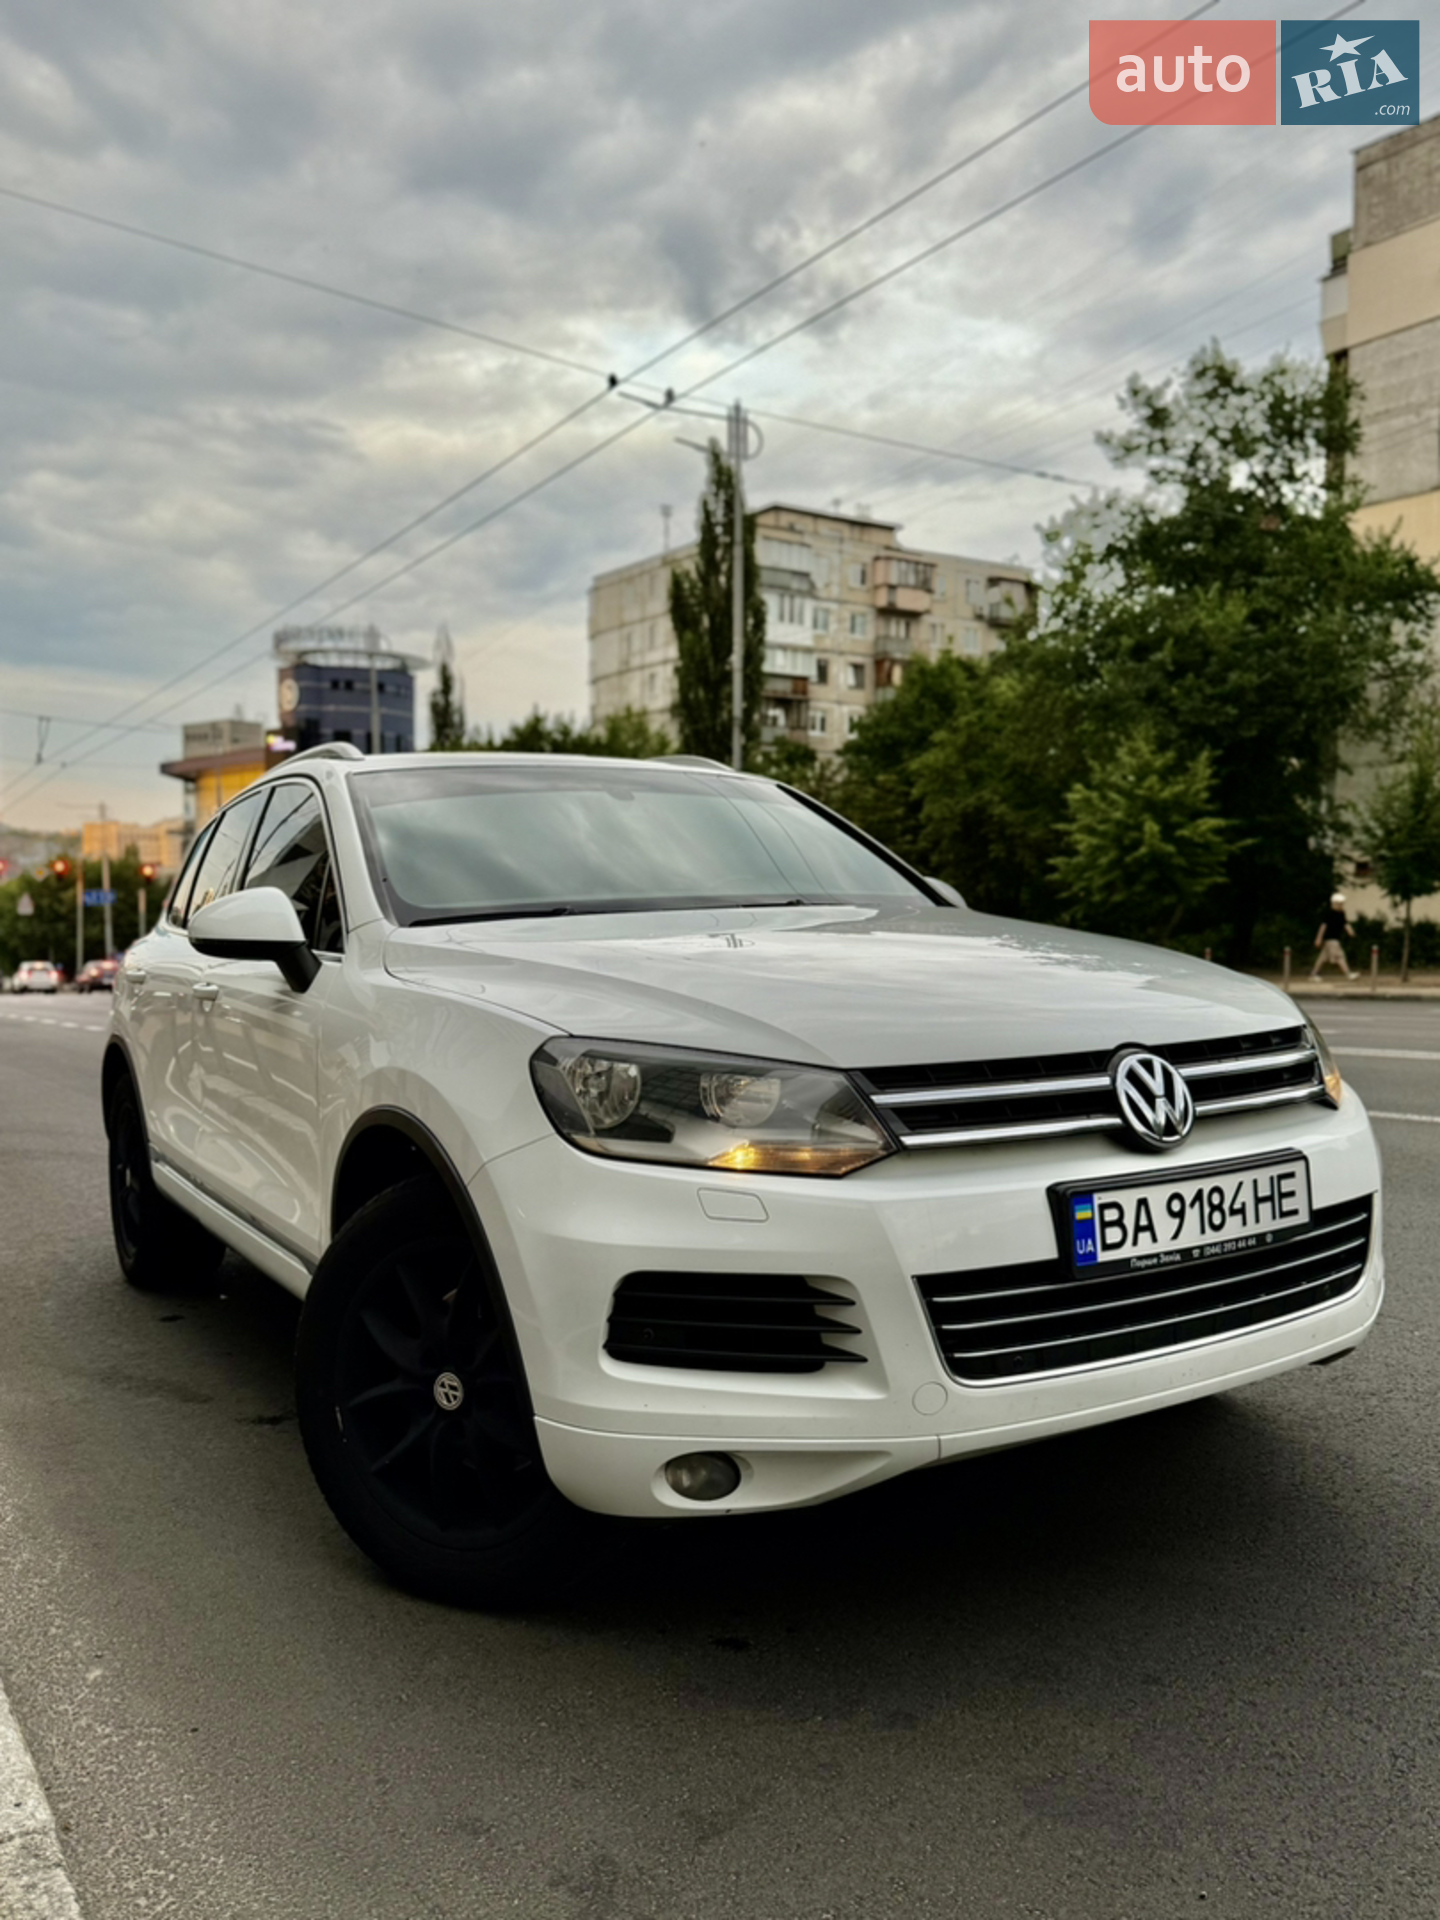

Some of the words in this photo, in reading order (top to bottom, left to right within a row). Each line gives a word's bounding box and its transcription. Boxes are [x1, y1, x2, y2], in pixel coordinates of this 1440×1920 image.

[1098, 1197, 1158, 1252] BA
[1165, 1181, 1247, 1241] 9184
[1253, 1171, 1300, 1225] HE
[1076, 1238, 1095, 1255] UA
